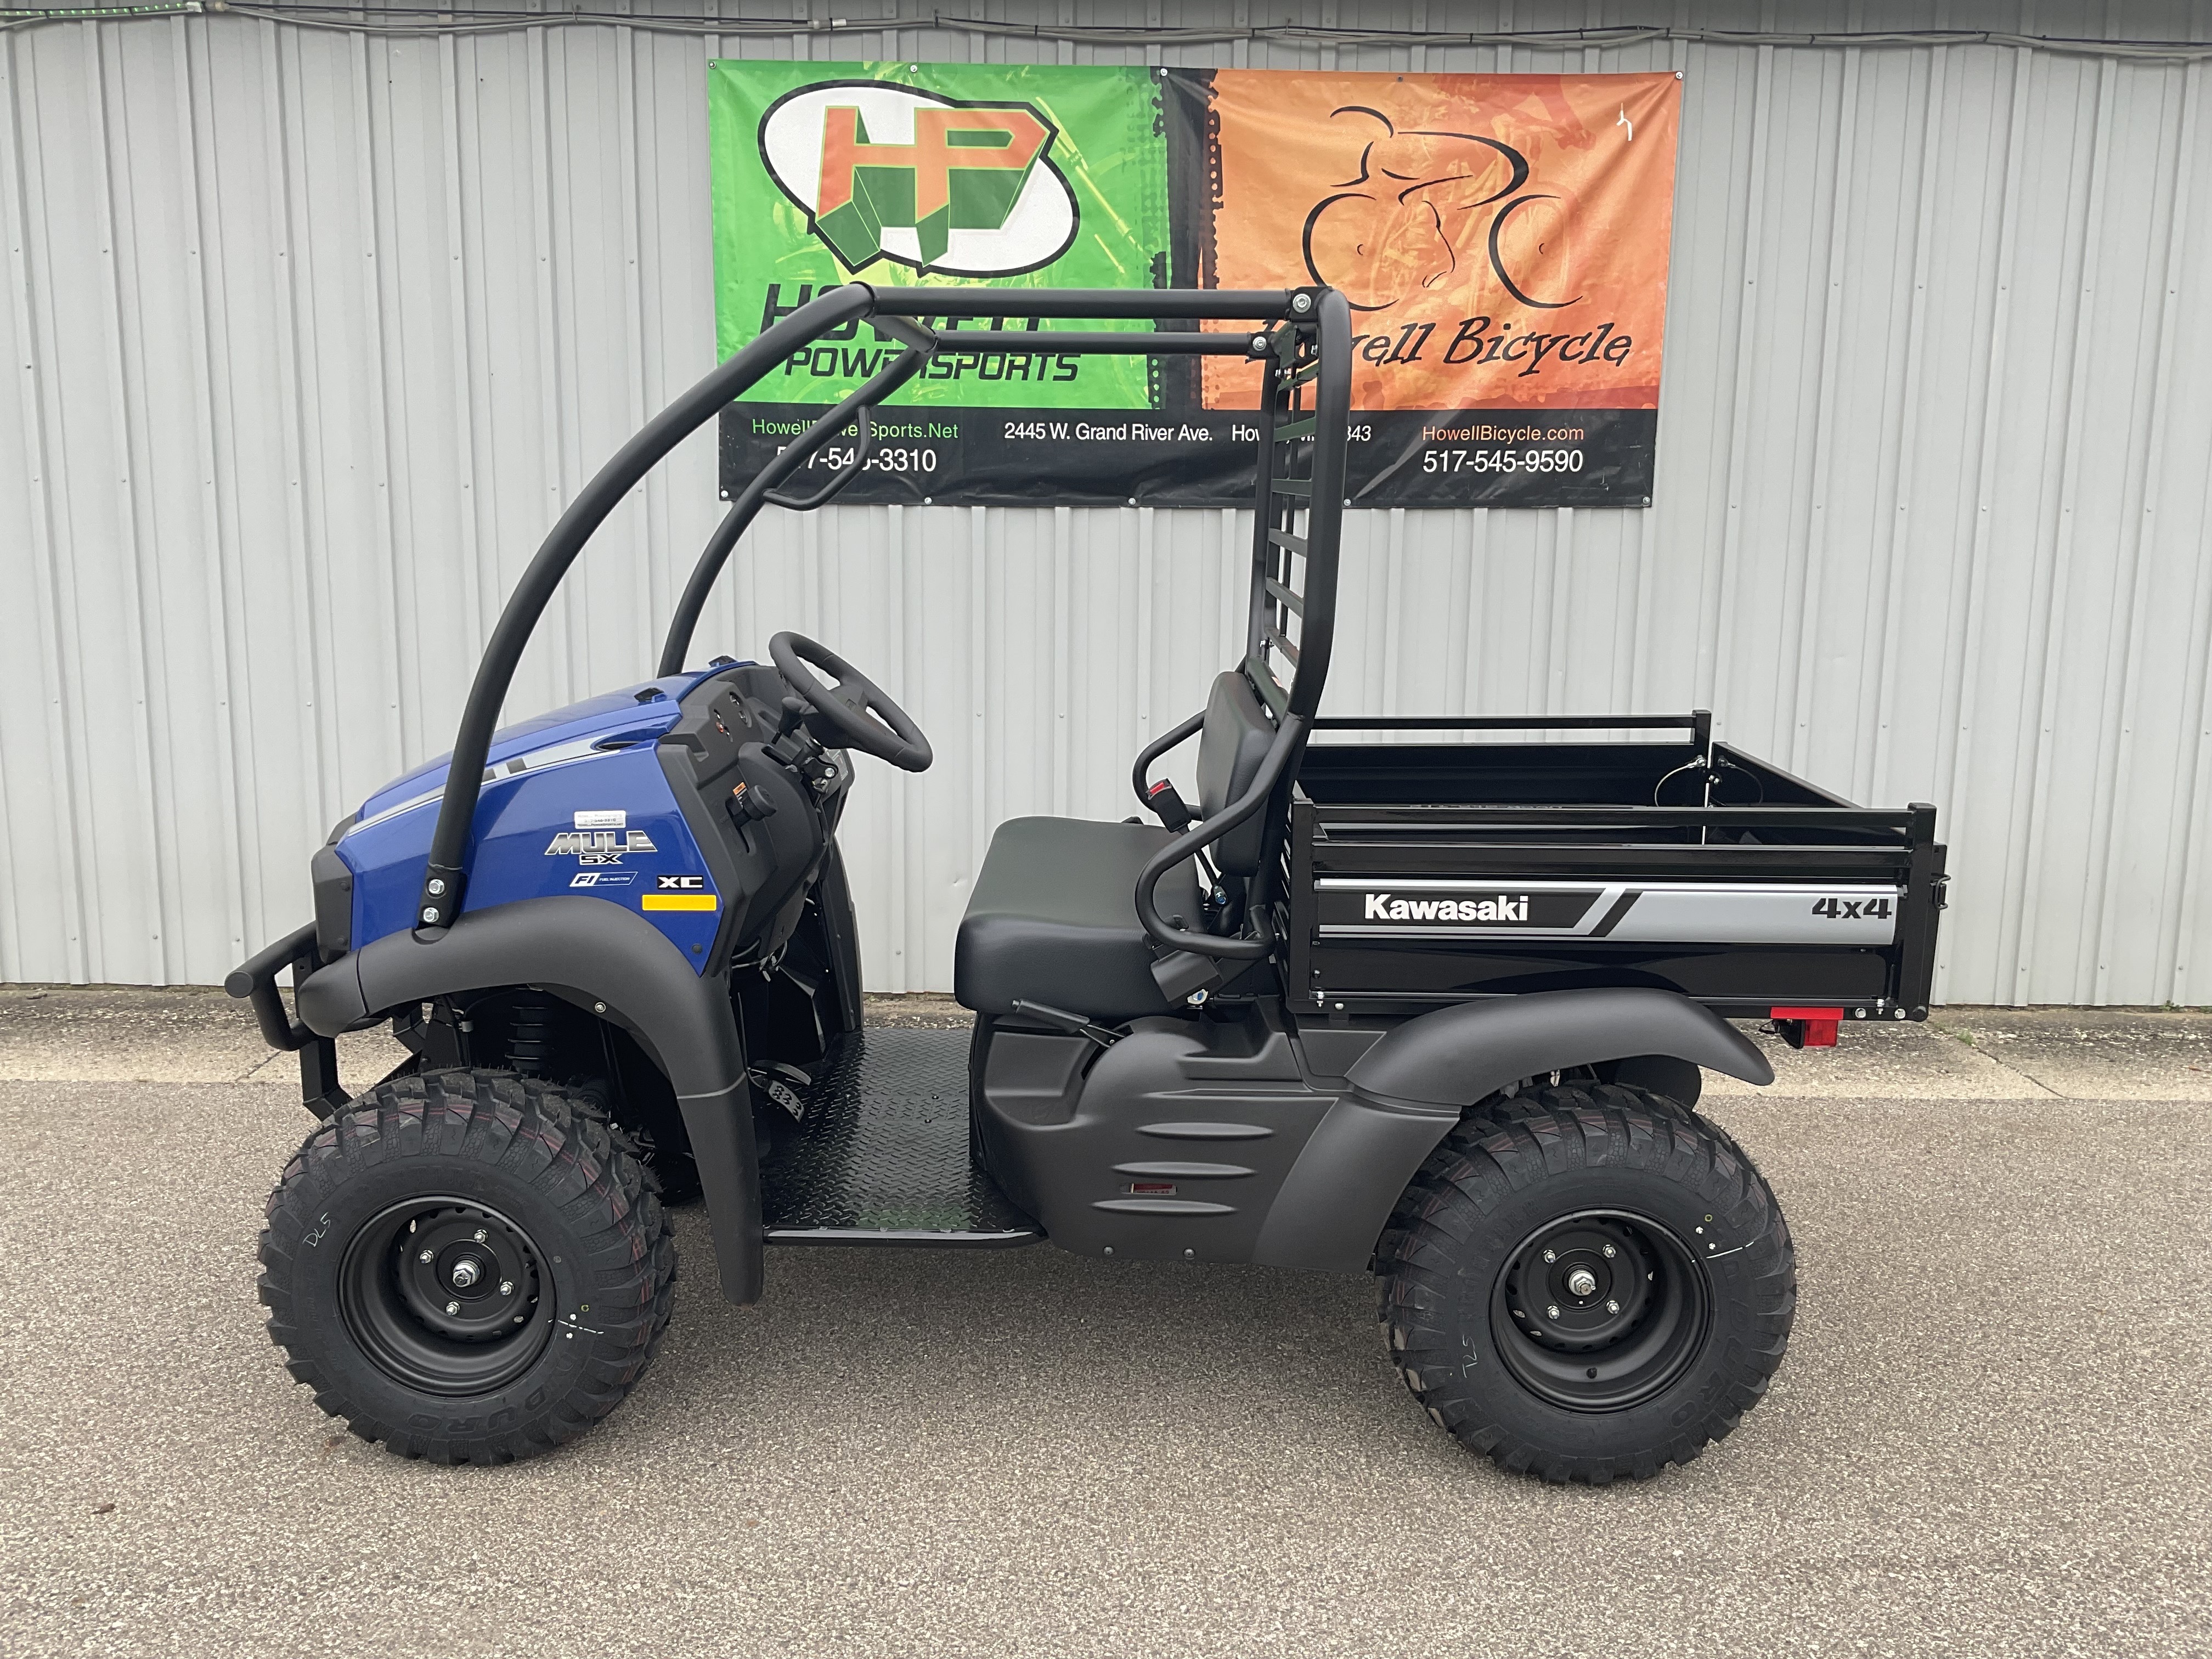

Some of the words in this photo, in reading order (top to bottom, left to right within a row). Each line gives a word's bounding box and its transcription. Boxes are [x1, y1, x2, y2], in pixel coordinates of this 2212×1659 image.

[816, 105, 1049, 247] HP
[1443, 317, 1633, 377] Bicycle
[785, 347, 1081, 382] POWSPORTS
[1005, 422, 1046, 439] 2445
[1049, 422, 1070, 439] W.
[1076, 423, 1126, 440] Grand
[1132, 424, 1175, 441] River
[1178, 424, 1213, 441] Ave.
[1423, 425, 1584, 444] HowellBicycle.com
[1423, 450, 1583, 472] 517-545-9590
[545, 831, 658, 855] MULE
[580, 853, 623, 865] SX
[574, 876, 596, 884] FI
[658, 877, 703, 888] XC
[1365, 894, 1528, 921] Kawasaki
[1812, 898, 1892, 919] 4x4
[407, 1383, 549, 1434] DURO
